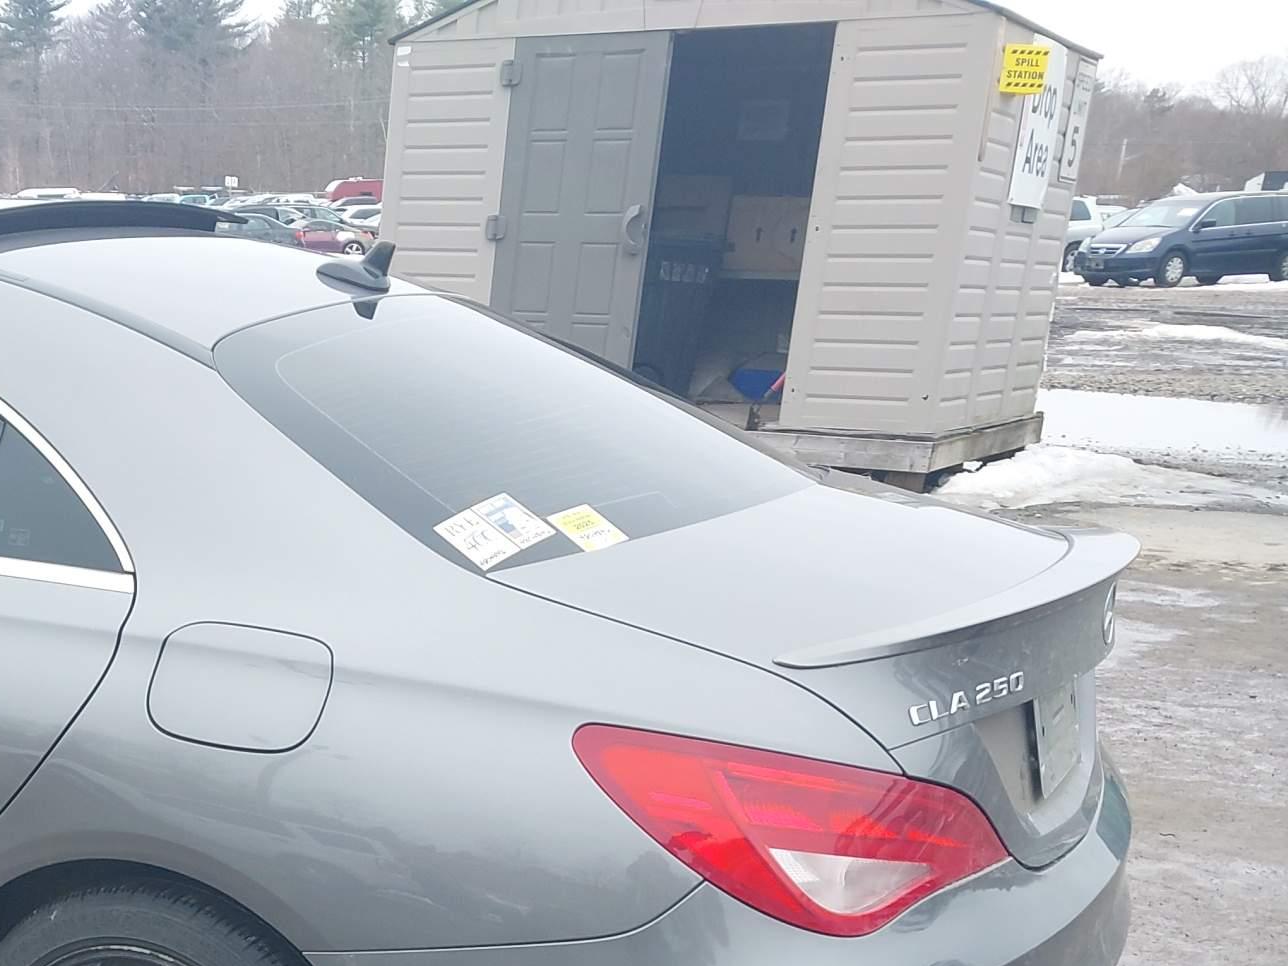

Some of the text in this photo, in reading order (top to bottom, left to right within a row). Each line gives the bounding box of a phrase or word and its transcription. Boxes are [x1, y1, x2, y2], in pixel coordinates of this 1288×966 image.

[1006, 69, 1045, 81] STATION
[1015, 57, 1040, 68] SPILL
[1022, 128, 1049, 178] Area
[1067, 126, 1080, 168] 5
[909, 671, 1024, 727] CLA 250
